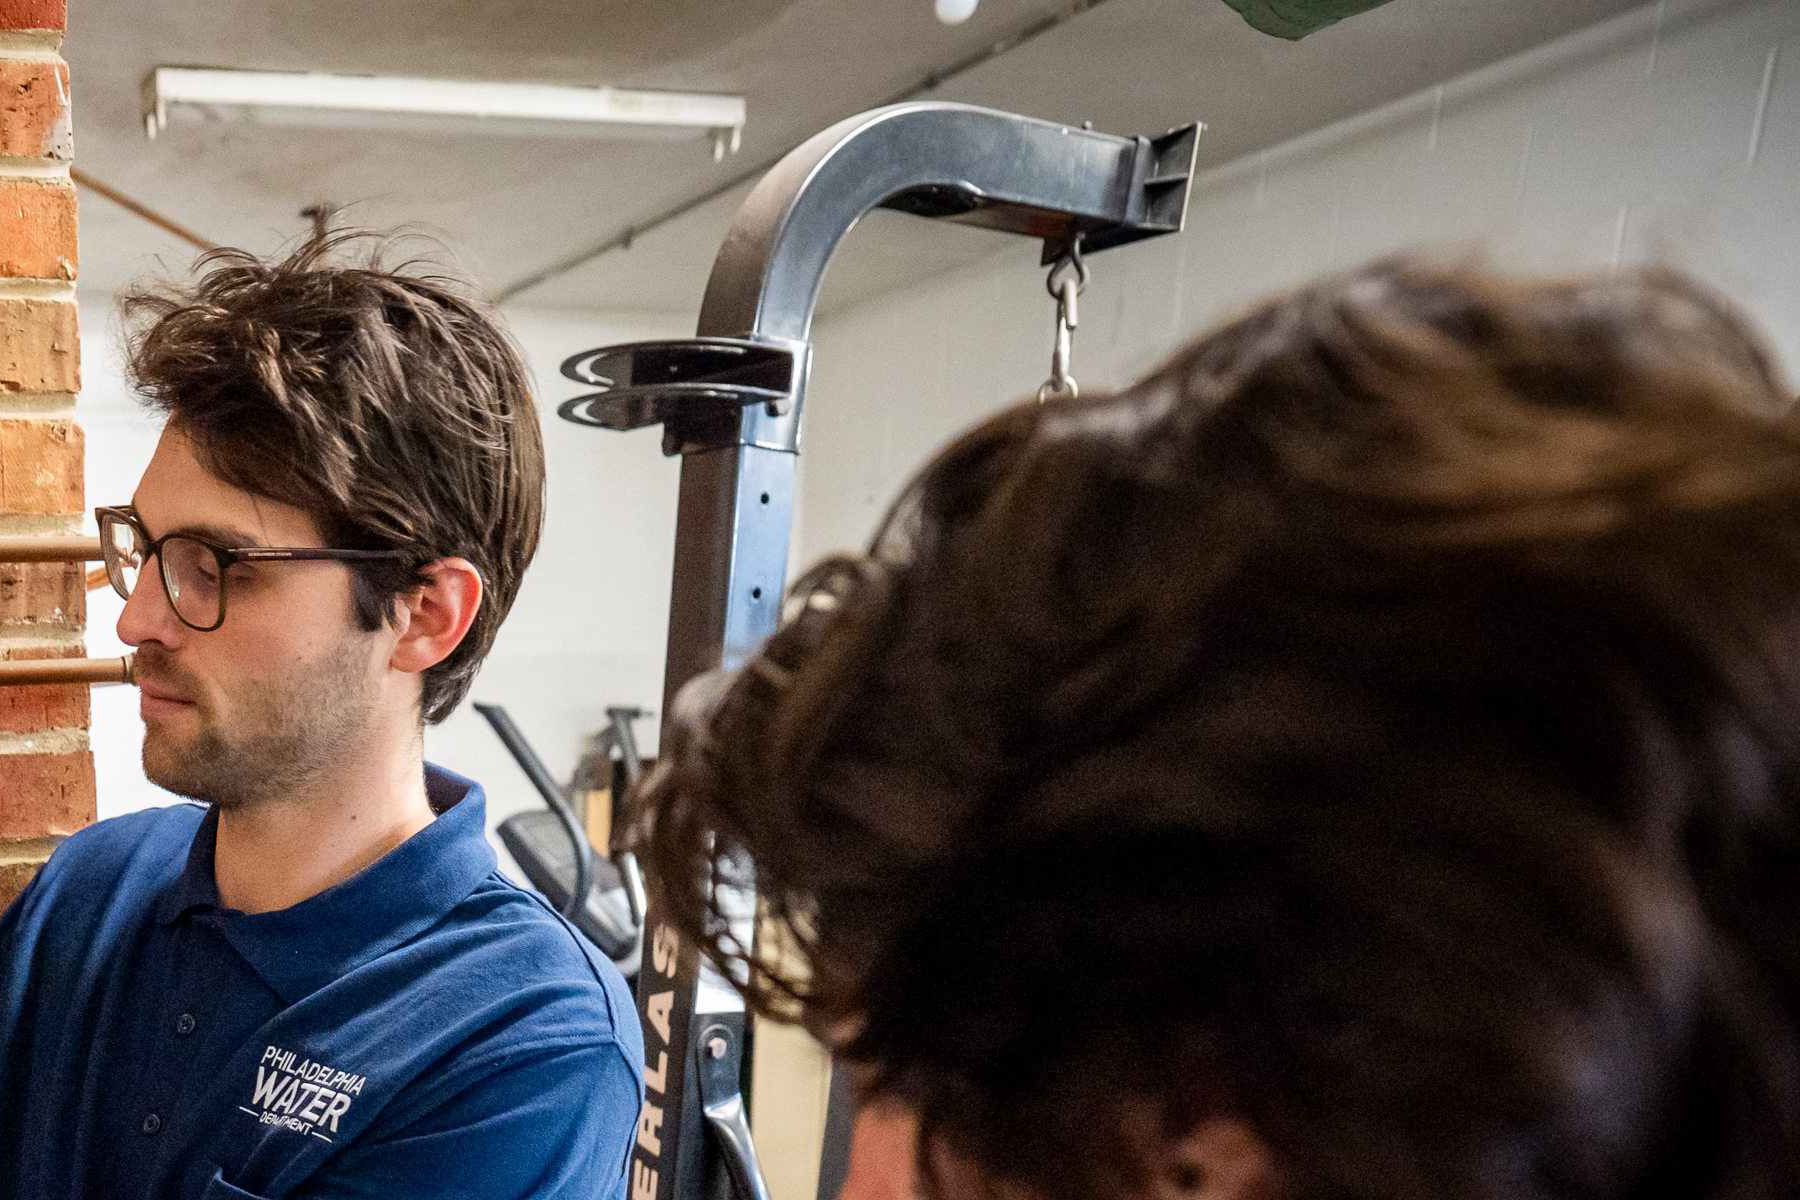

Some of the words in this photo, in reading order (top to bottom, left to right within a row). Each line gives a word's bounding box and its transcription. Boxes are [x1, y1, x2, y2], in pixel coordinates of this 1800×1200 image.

[260, 1045, 367, 1096] PHILADELPHIA
[252, 1066, 352, 1133] WATER
[259, 1111, 313, 1136] DEPARTMENT
